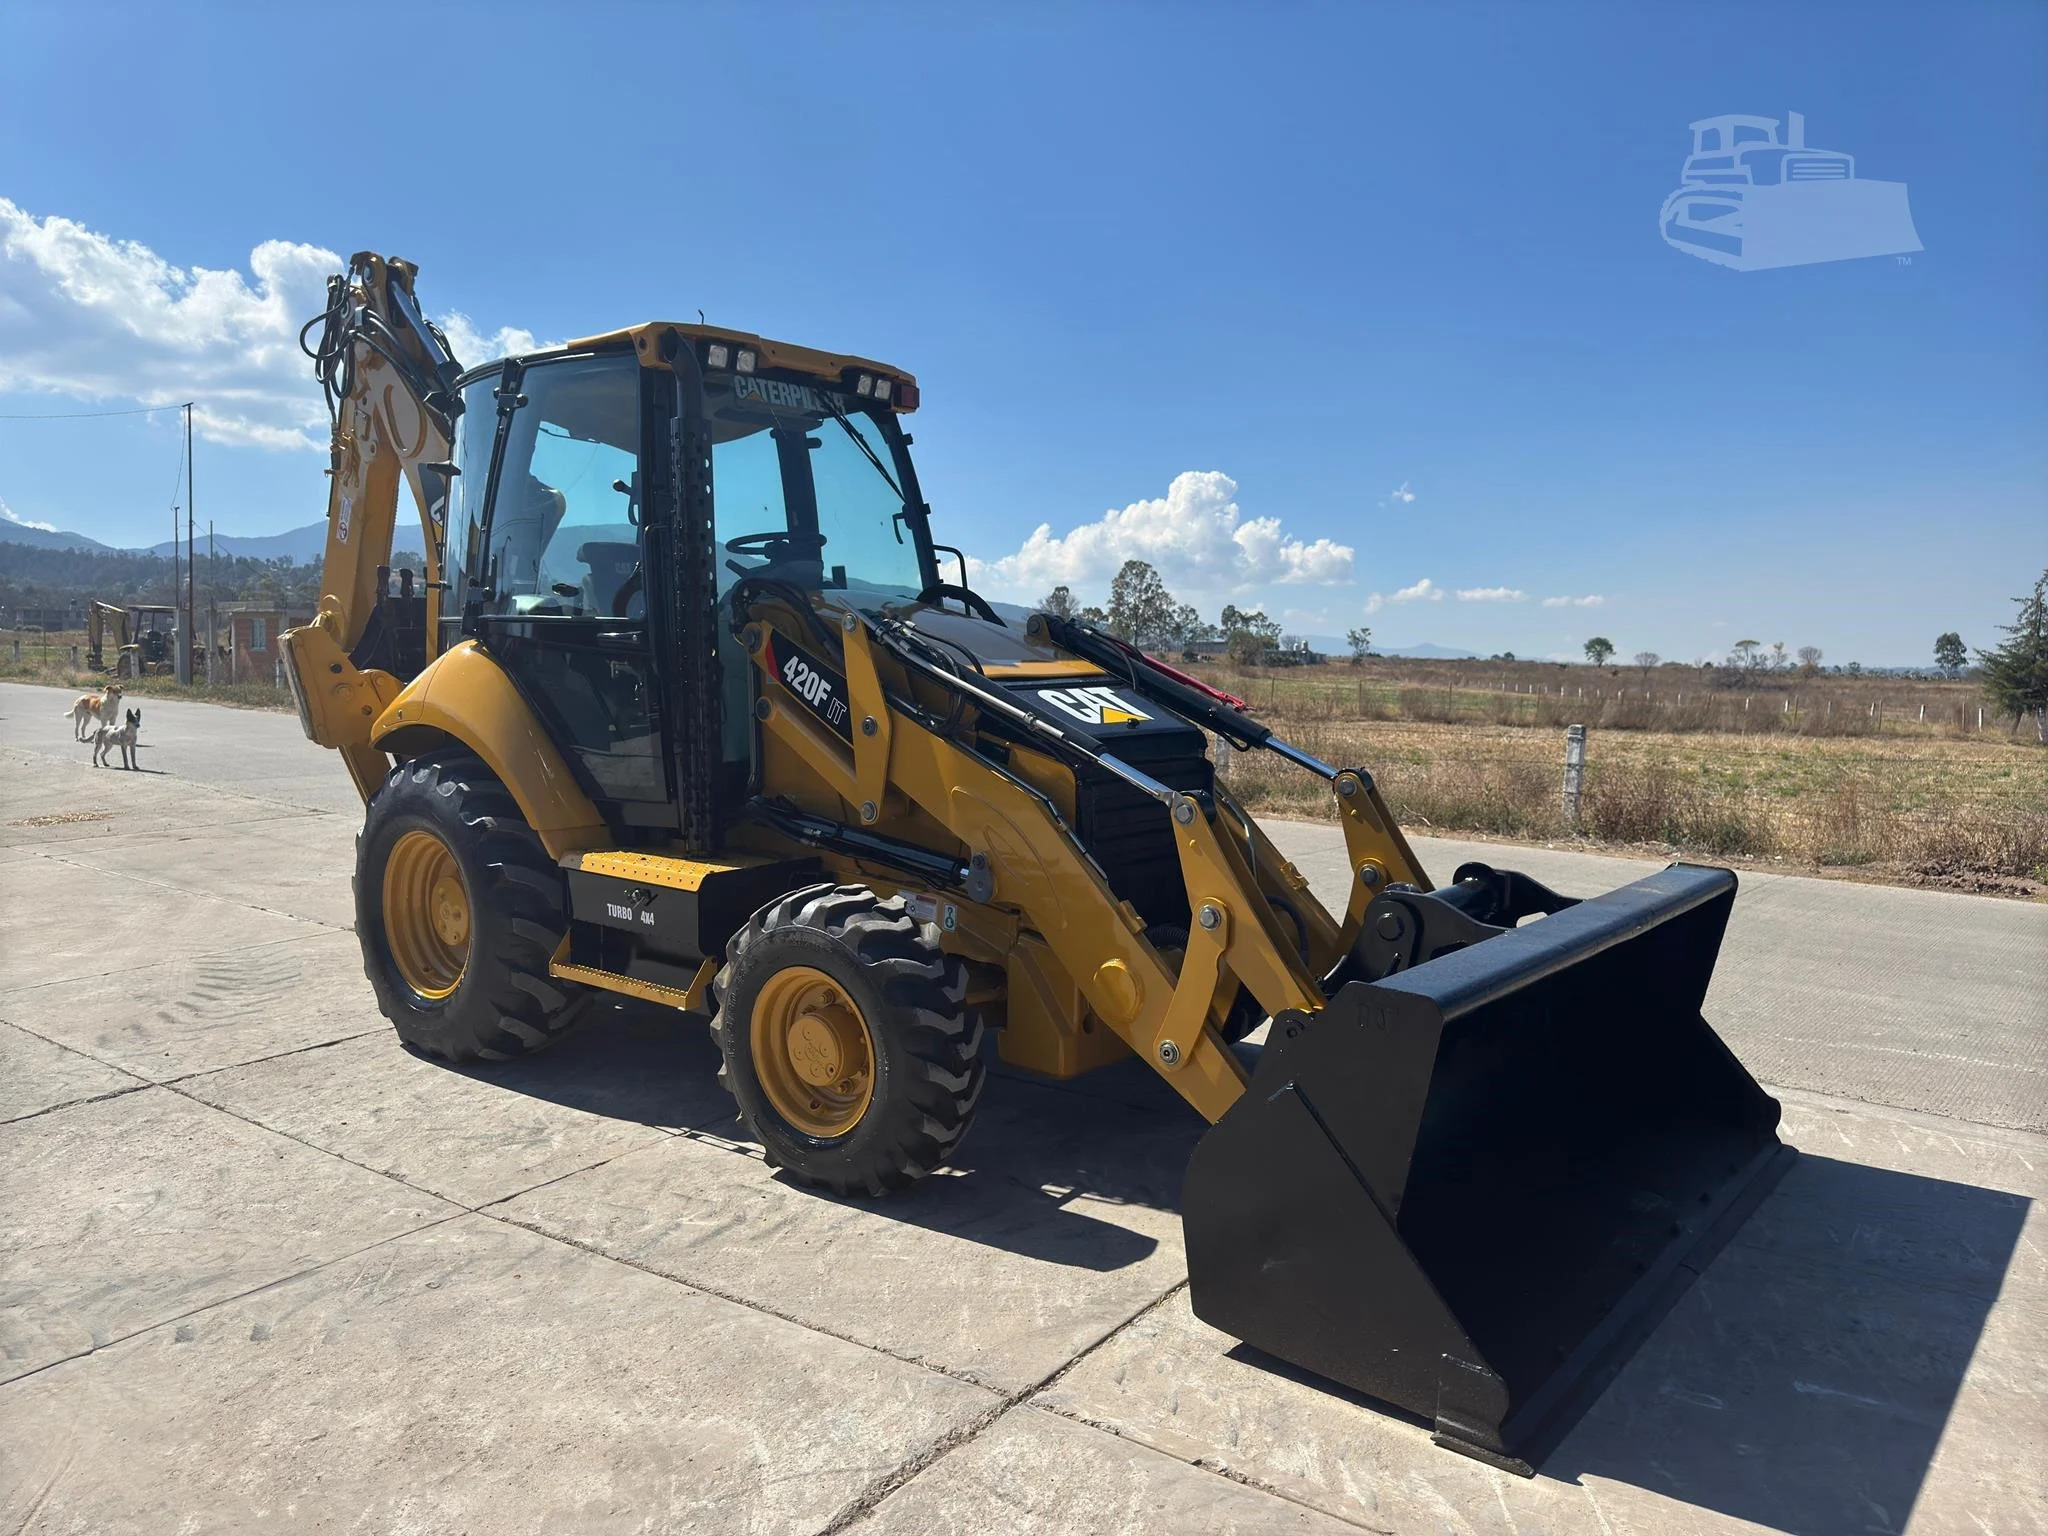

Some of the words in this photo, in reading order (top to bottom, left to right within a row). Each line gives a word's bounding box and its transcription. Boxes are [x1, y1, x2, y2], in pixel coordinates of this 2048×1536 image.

[783, 655, 832, 707] 420F
[826, 696, 848, 725] IT
[1037, 686, 1155, 724] CAT
[607, 903, 633, 921] TURBO
